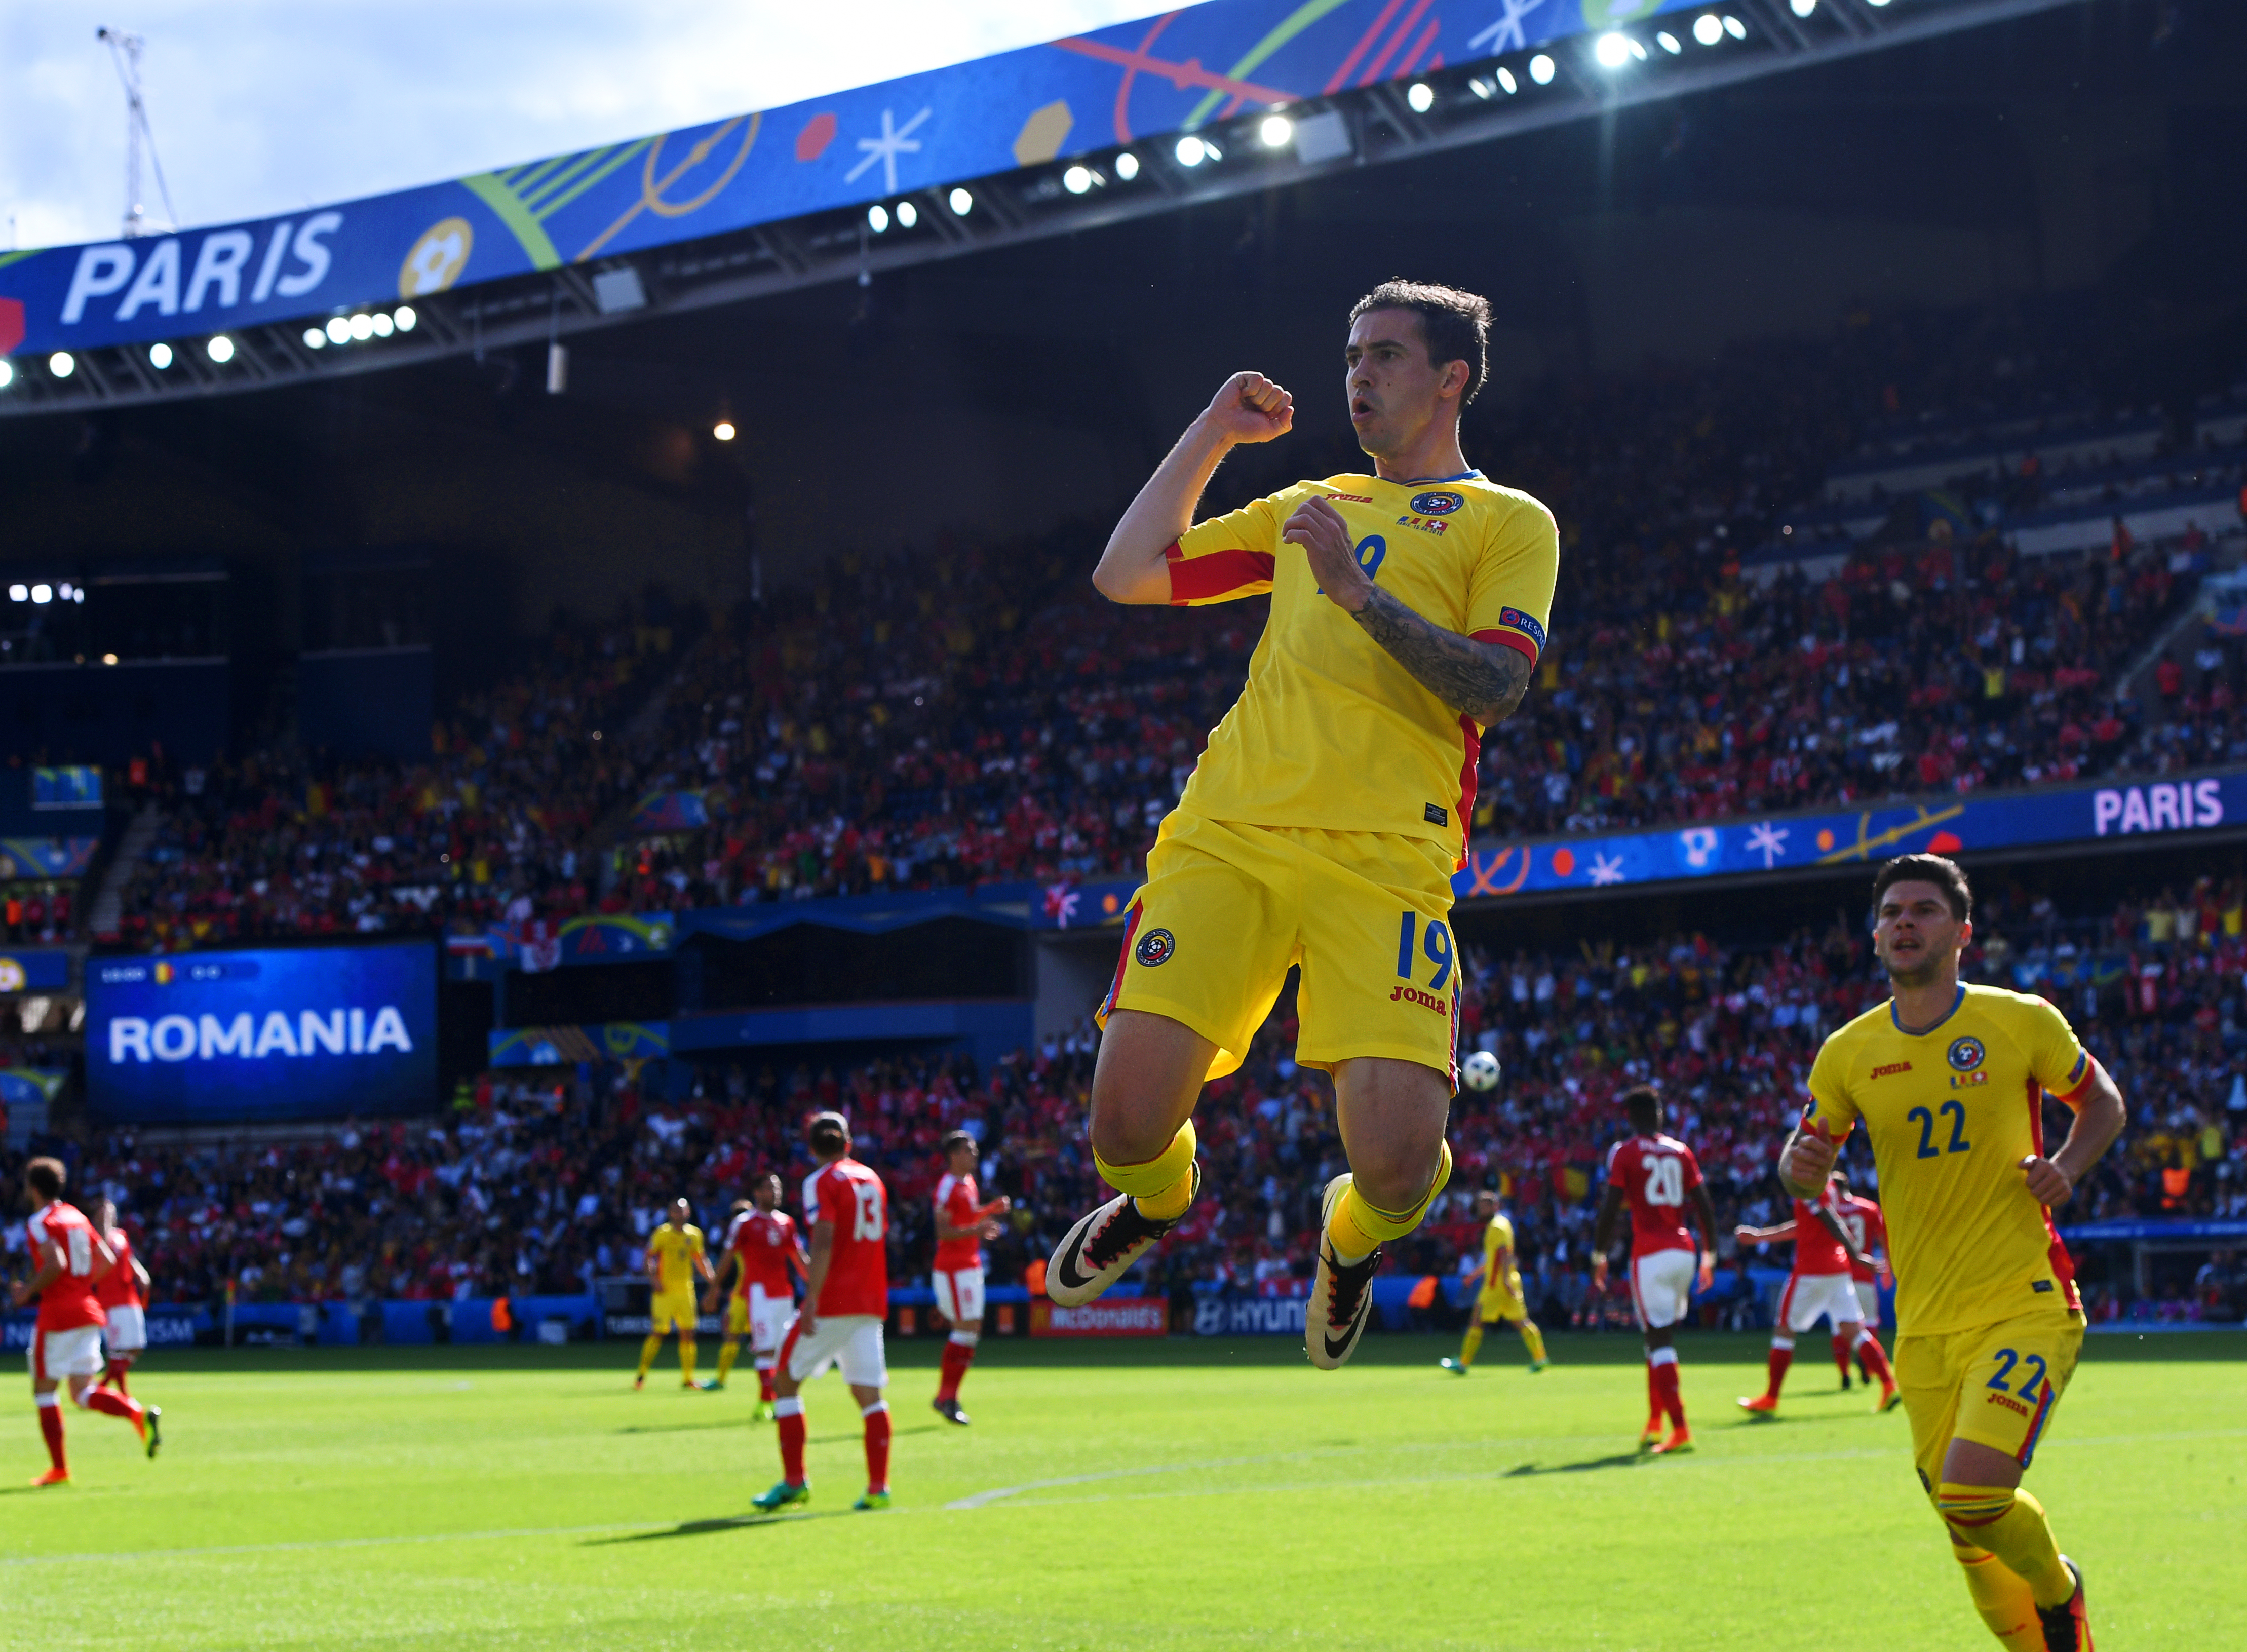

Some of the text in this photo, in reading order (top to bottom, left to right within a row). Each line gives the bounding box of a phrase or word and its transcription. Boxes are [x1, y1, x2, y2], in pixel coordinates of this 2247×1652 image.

[60, 211, 344, 325] PARIS
[1316, 534, 1386, 594] 9
[2094, 778, 2224, 836] PARIS
[1397, 911, 1453, 991] 19
[1389, 986, 1447, 1016] Joma
[109, 1006, 413, 1063] ROMANIA
[1907, 1099, 1971, 1160] 22
[1642, 1154, 1684, 1208] 20
[852, 1183, 883, 1242] 13
[1050, 1303, 1162, 1331] McDonald's
[1229, 1299, 1306, 1333] HYUN
[1986, 1348, 2047, 1405] 22
